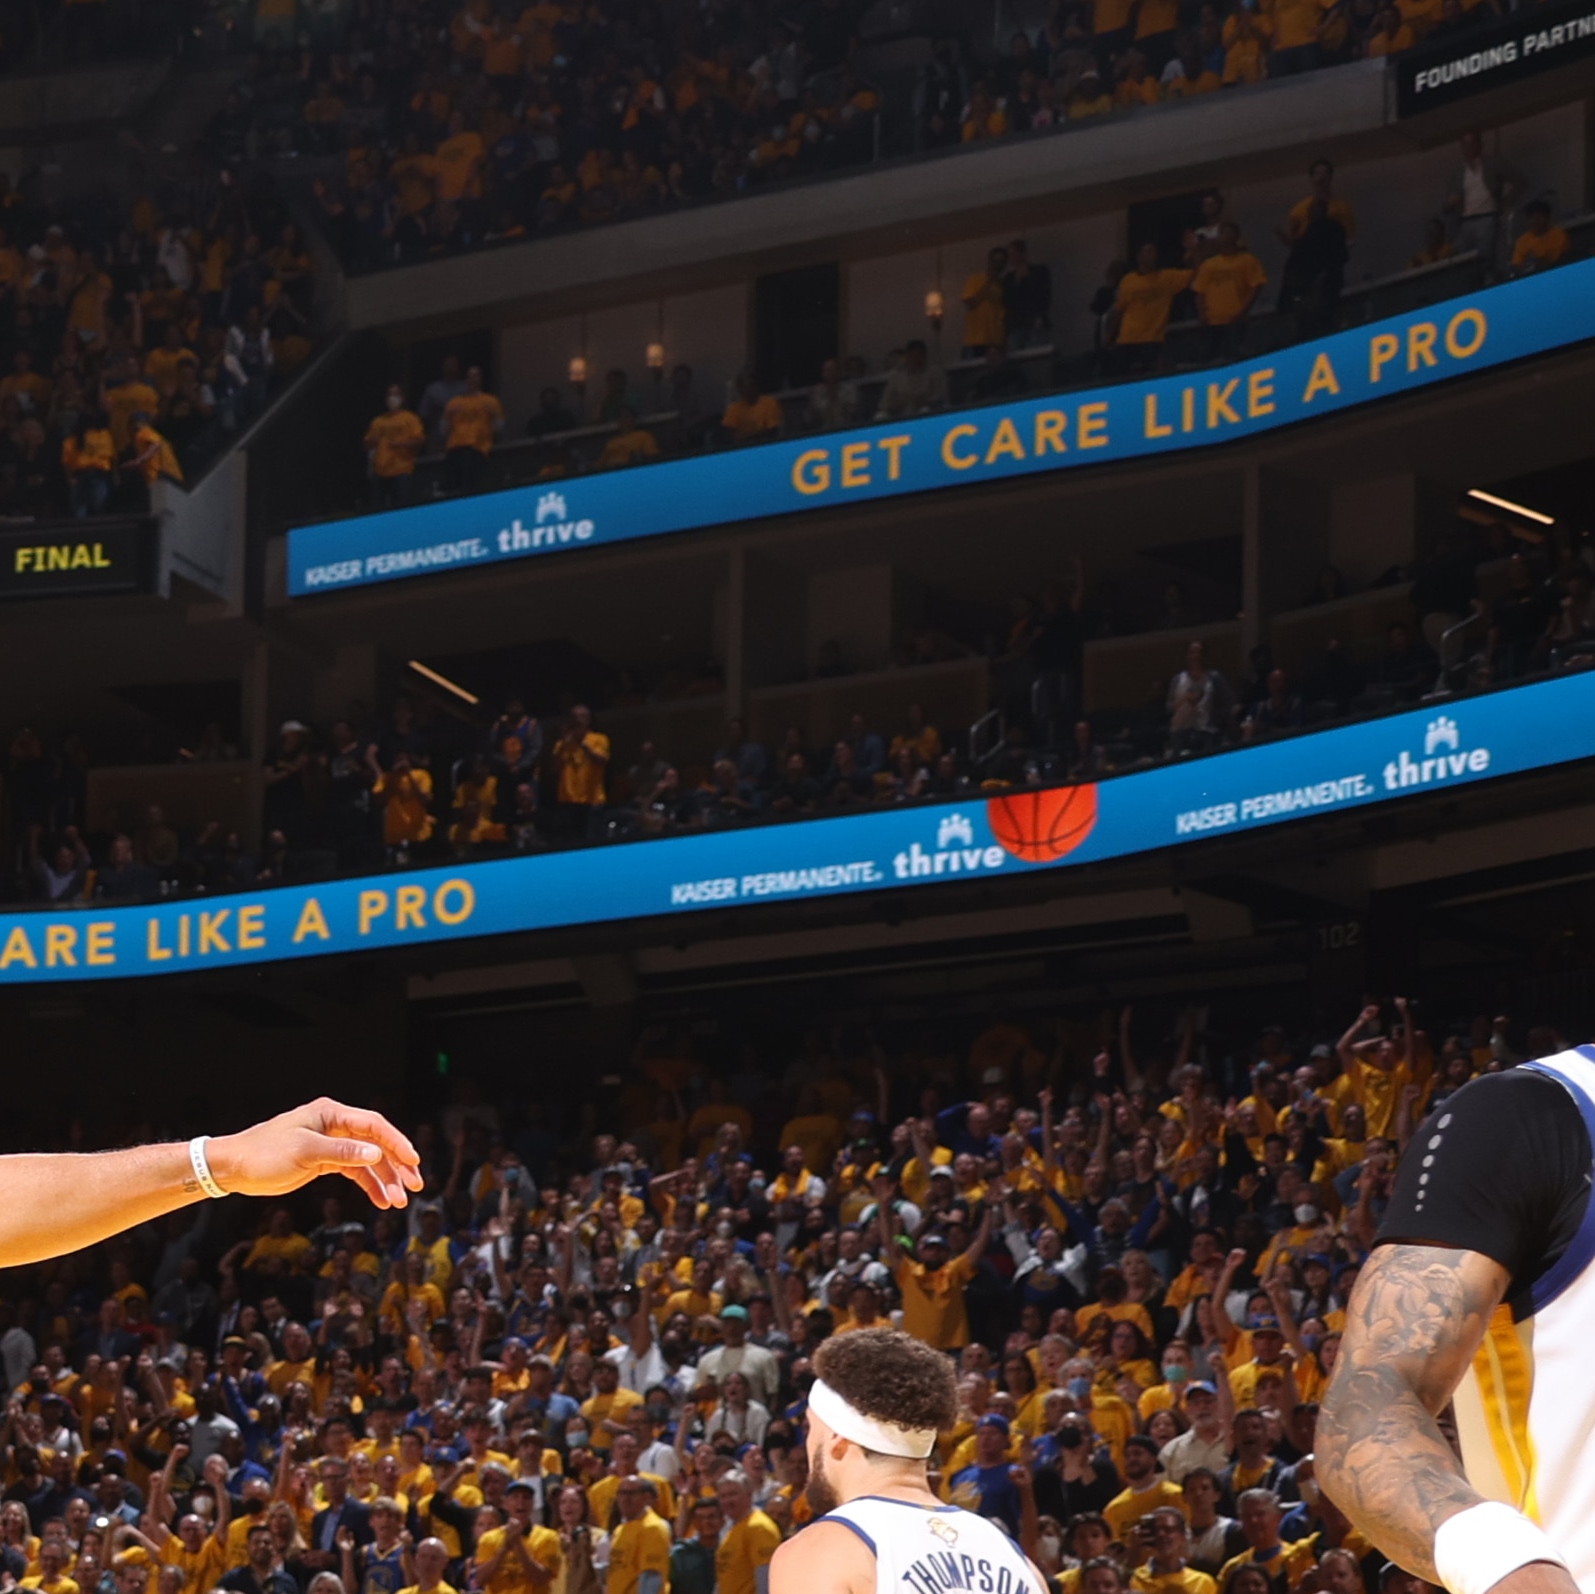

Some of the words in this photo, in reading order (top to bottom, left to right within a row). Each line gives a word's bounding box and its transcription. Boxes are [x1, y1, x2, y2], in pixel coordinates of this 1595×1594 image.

[1415, 41, 1518, 94] FOUNDING
[791, 436, 912, 496] GET
[940, 401, 1109, 471] CARE
[1144, 367, 1276, 440] LIKE
[1302, 352, 1340, 404] A
[1369, 307, 1488, 384] PRO
[498, 515, 595, 554] thrive
[15, 543, 110, 573] FINAL
[306, 558, 363, 587] KAISER
[1382, 743, 1491, 792] thrive
[1175, 799, 1239, 836] KAISER
[893, 836, 1006, 880] thrive
[671, 875, 737, 905] KAISER
[146, 903, 268, 963] LIKE
[292, 898, 331, 944] A
[357, 877, 477, 936] PRO
[1318, 920, 1359, 950] 102
